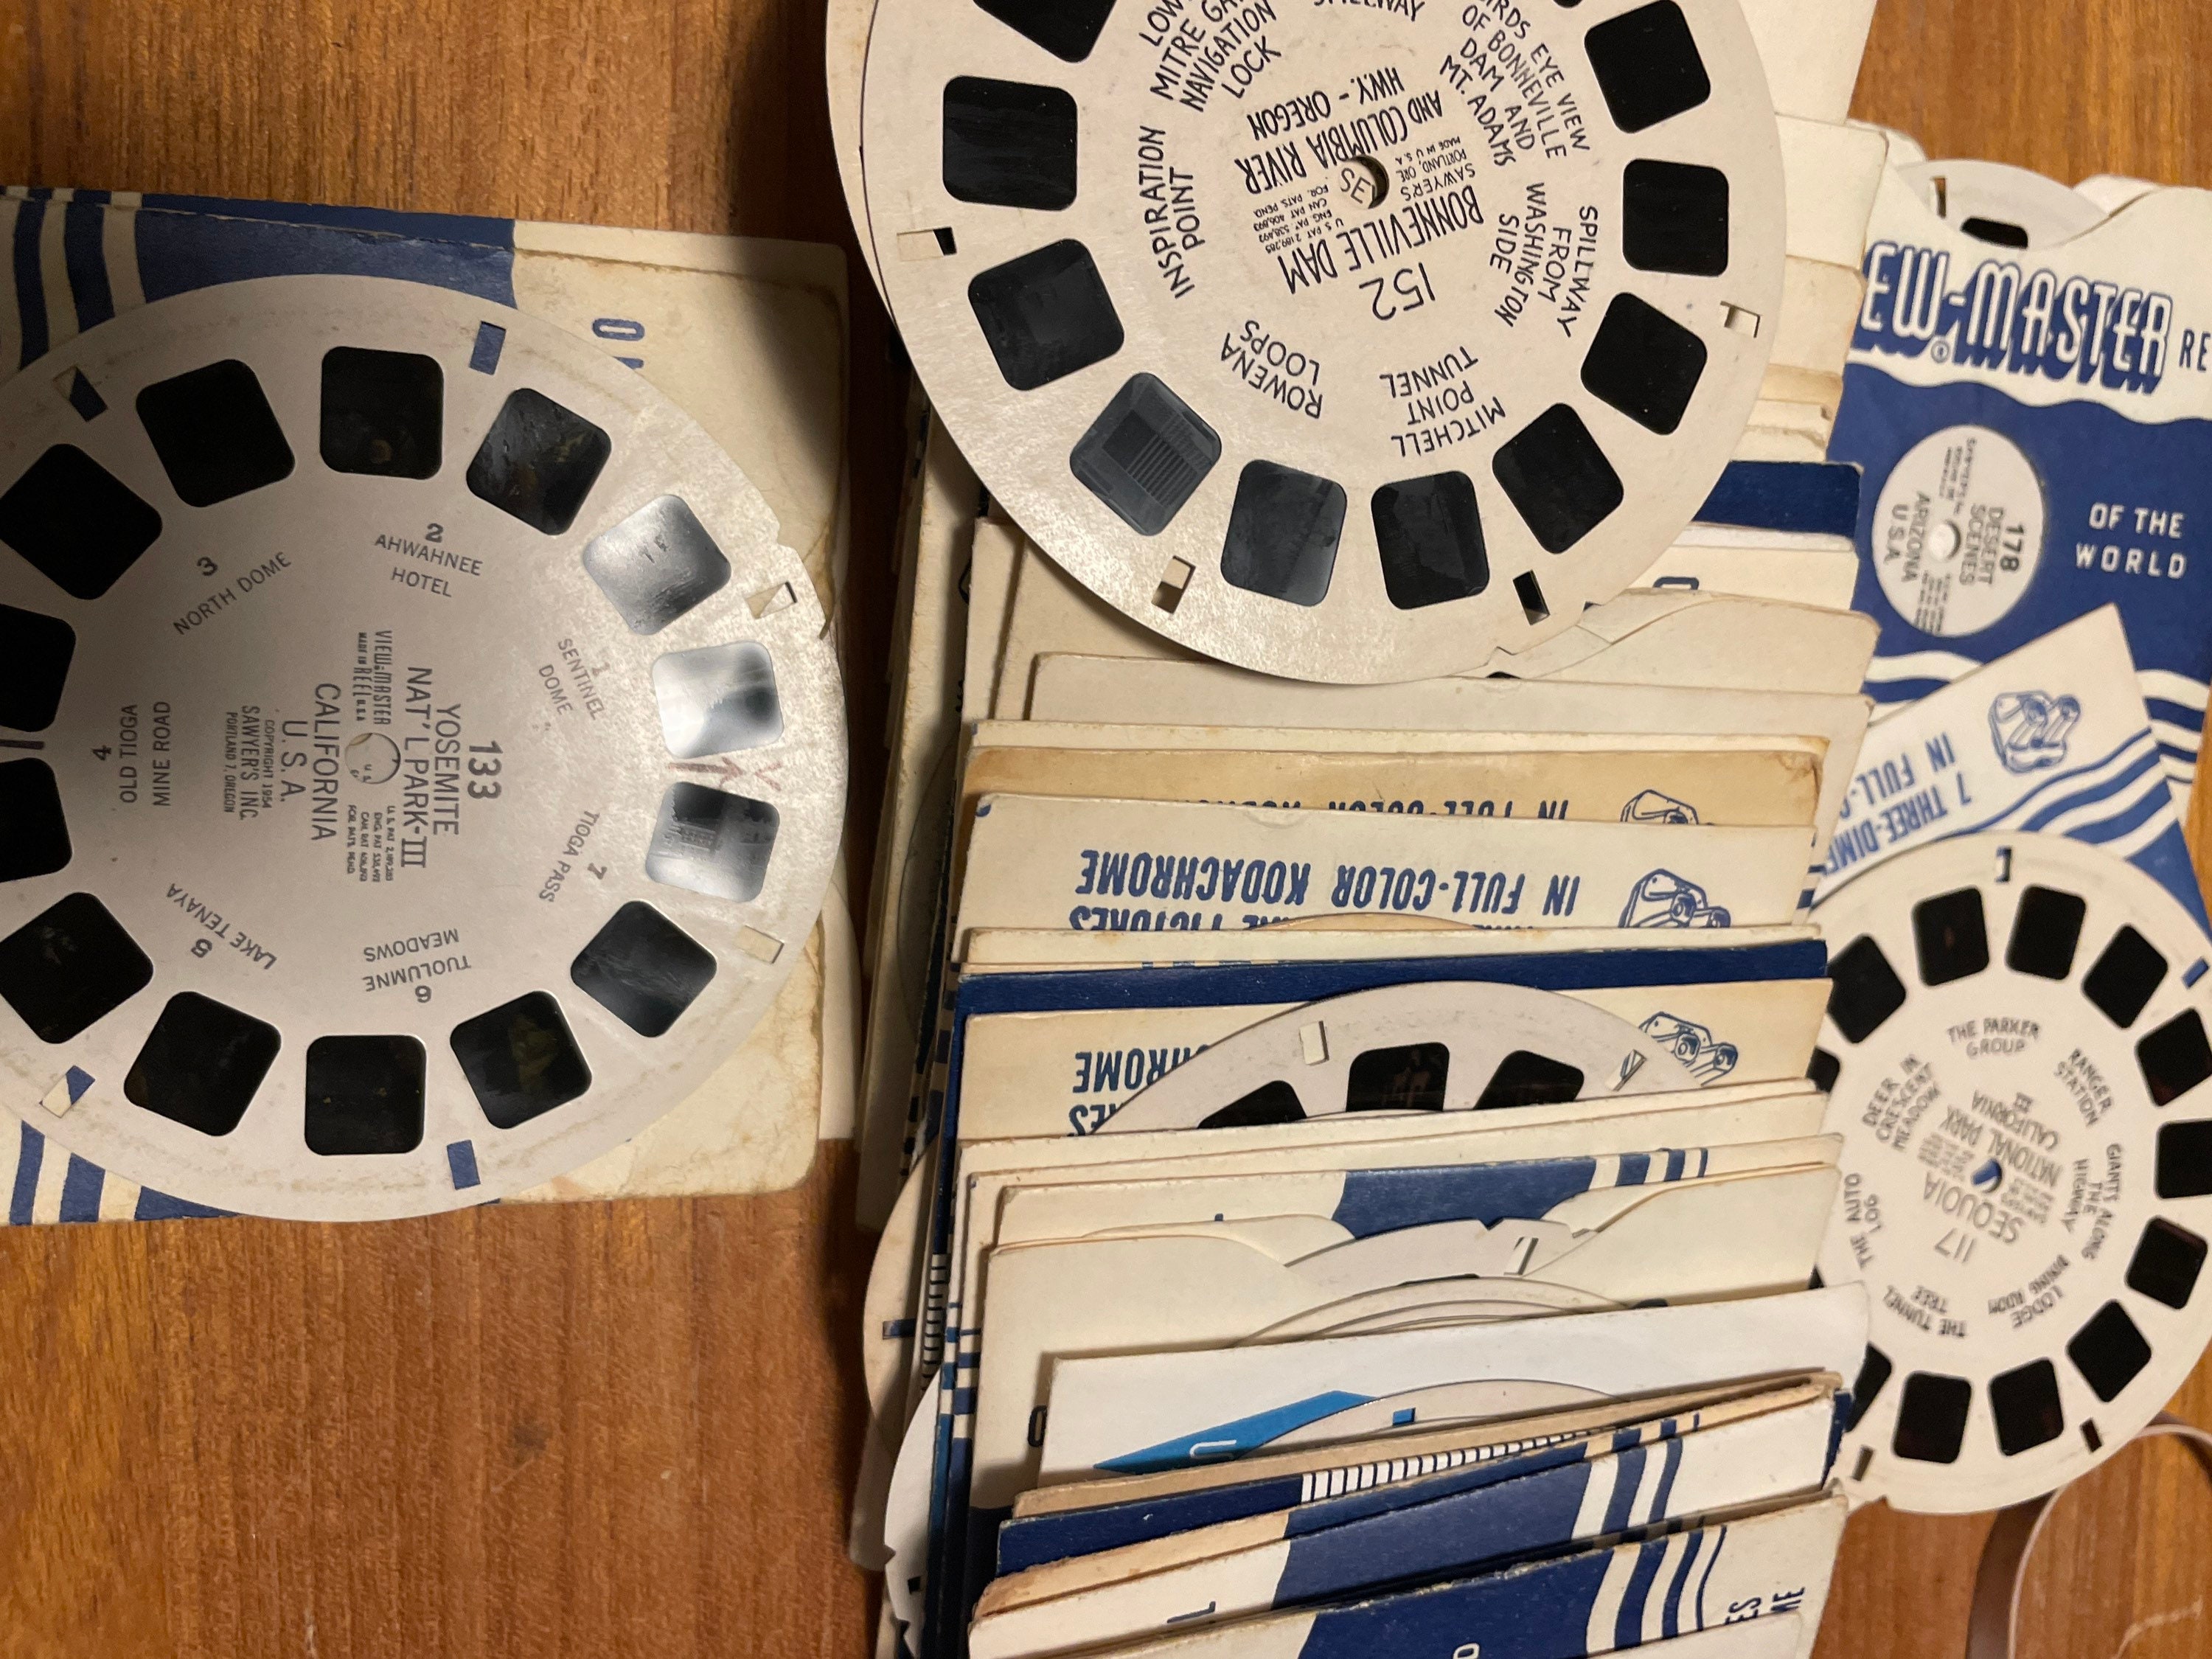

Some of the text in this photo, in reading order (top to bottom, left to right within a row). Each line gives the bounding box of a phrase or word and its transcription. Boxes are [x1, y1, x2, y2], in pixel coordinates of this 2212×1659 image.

[1139, 0, 1186, 46] LOW
[1150, 0, 1244, 100] MITRE GA
[1180, 0, 1277, 111] NAVIGATION
[1221, 35, 1281, 99] LOCK
[1462, 4, 1567, 159] OF BONNEVILLE
[1246, 90, 1332, 141] OREGON
[1439, 55, 1516, 167] MT. ADAMS
[1460, 38, 1536, 150] DAM AND
[1530, 43, 1565, 88] EYE
[1557, 92, 1590, 150] VIEW
[1234, 90, 1443, 195] AND COLUMBIA RIVER
[1419, 148, 1467, 173] PORTLAND,
[1426, 144, 1436, 155] IN
[1439, 136, 1461, 150] MADE
[1138, 125, 1195, 299] INSPIRATION
[1169, 166, 1206, 251] POINT
[1400, 163, 1475, 201] SAWYER'S
[1277, 184, 1484, 295] BONNEVILLE DAM
[1290, 206, 1306, 219] PAT
[1307, 226, 1322, 239] PAT
[1489, 212, 1520, 274] SIDE
[1494, 182, 1547, 327] WASHINGTON
[1537, 226, 1572, 303] FROM
[1557, 205, 1599, 338] SPILLWAY
[1359, 262, 1436, 321] 152
[1220, 333, 1324, 420] ROWENA
[1239, 319, 1321, 386] LOOPS
[1379, 346, 1479, 398] TUNNEL
[1391, 396, 1506, 458] MITCHELL
[1407, 380, 1475, 426] POINT
[425, 522, 444, 543] 2
[1901, 491, 1931, 583] ARIZONA
[1958, 503, 1986, 586] SCENES
[1978, 505, 2005, 585] DESERT
[1999, 524, 2025, 572] 178
[2088, 501, 2185, 539] OF THE
[196, 555, 218, 577] 3
[375, 533, 484, 576] AHWAHNEE
[390, 566, 453, 598] HOTEL
[2075, 542, 2188, 580] WORLD
[172, 551, 292, 636] NORTH DOME
[352, 667, 373, 697] REEL
[538, 664, 574, 716] DOME
[557, 637, 605, 720] SENTINEL
[91, 745, 112, 761] 4
[119, 704, 139, 804] OLD TIOGA
[153, 701, 171, 807] MINE ROAD
[225, 712, 238, 761] PORTLAND
[240, 705, 260, 781] SAWYER'S
[261, 720, 275, 809] COPYRIGHT 1954
[311, 683, 341, 841] CALIFORNIA
[1925, 731, 1956, 773] IN
[224, 775, 237, 813] OREGON
[433, 703, 461, 835] YOSEMITE
[467, 740, 504, 800] 133
[1955, 770, 1972, 806] 7
[538, 810, 601, 902] TIOGA PASS
[587, 862, 608, 880] 7
[1074, 849, 1581, 917] IN FULL-COLOR KODACHROME
[166, 883, 278, 971] LAKE TENAYA
[190, 937, 213, 958] 5
[363, 928, 460, 962] MEADOWS
[361, 955, 472, 992] TUOLUMNE
[414, 985, 433, 1004] 6
[1947, 1017, 2041, 1044] THE PARKER
[1966, 1037, 2026, 1060] GROUP
[1863, 1077, 1901, 1127] DEER
[2053, 1060, 2098, 1128] STATION
[2068, 1048, 2112, 1113] RANGER
[1938, 1105, 1985, 1147] PARK
[1971, 1089, 2059, 1152] CALIFORNIA
[1988, 1127, 2063, 1188] NATIONAL
[1843, 1172, 1874, 1270] THE AUTO
[1863, 1193, 1884, 1234] LOG
[1923, 1170, 2026, 1244] SEQUOIA
[2082, 1181, 2104, 1214] THE
[1938, 1318, 1967, 1338] THE
[2009, 1284, 2065, 1329] LODGE
